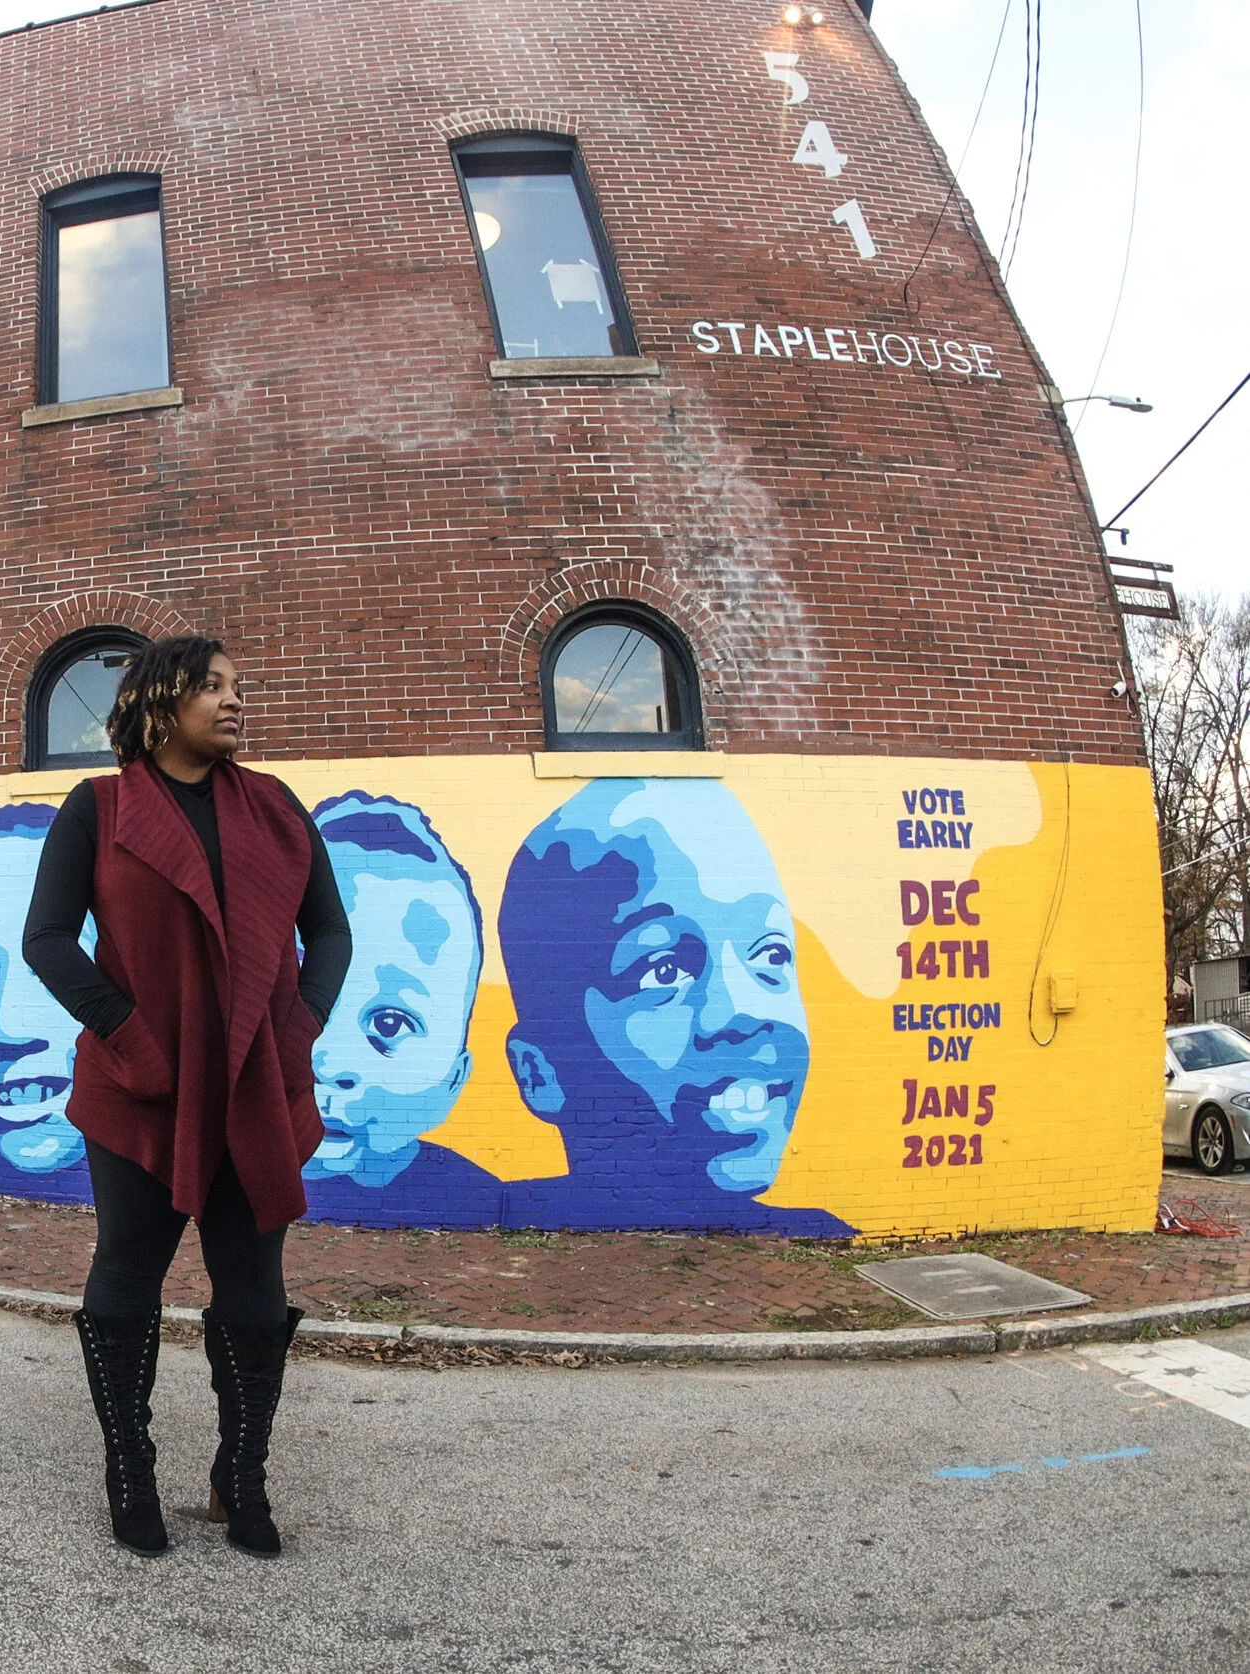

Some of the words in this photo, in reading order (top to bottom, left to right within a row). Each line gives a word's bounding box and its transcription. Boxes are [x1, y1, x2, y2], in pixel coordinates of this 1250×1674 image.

[691, 320, 1002, 380] STAPLEHOUSE
[901, 788, 967, 816] VOTE
[897, 820, 974, 850] EARLY
[900, 879, 981, 927] DEC
[895, 939, 991, 981] 14TH
[892, 1002, 1002, 1033] ELECTION
[926, 1035, 974, 1063] DAY
[900, 1077, 970, 1127] JAN
[973, 1083, 997, 1128] 5
[901, 1133, 984, 1170] 2021
